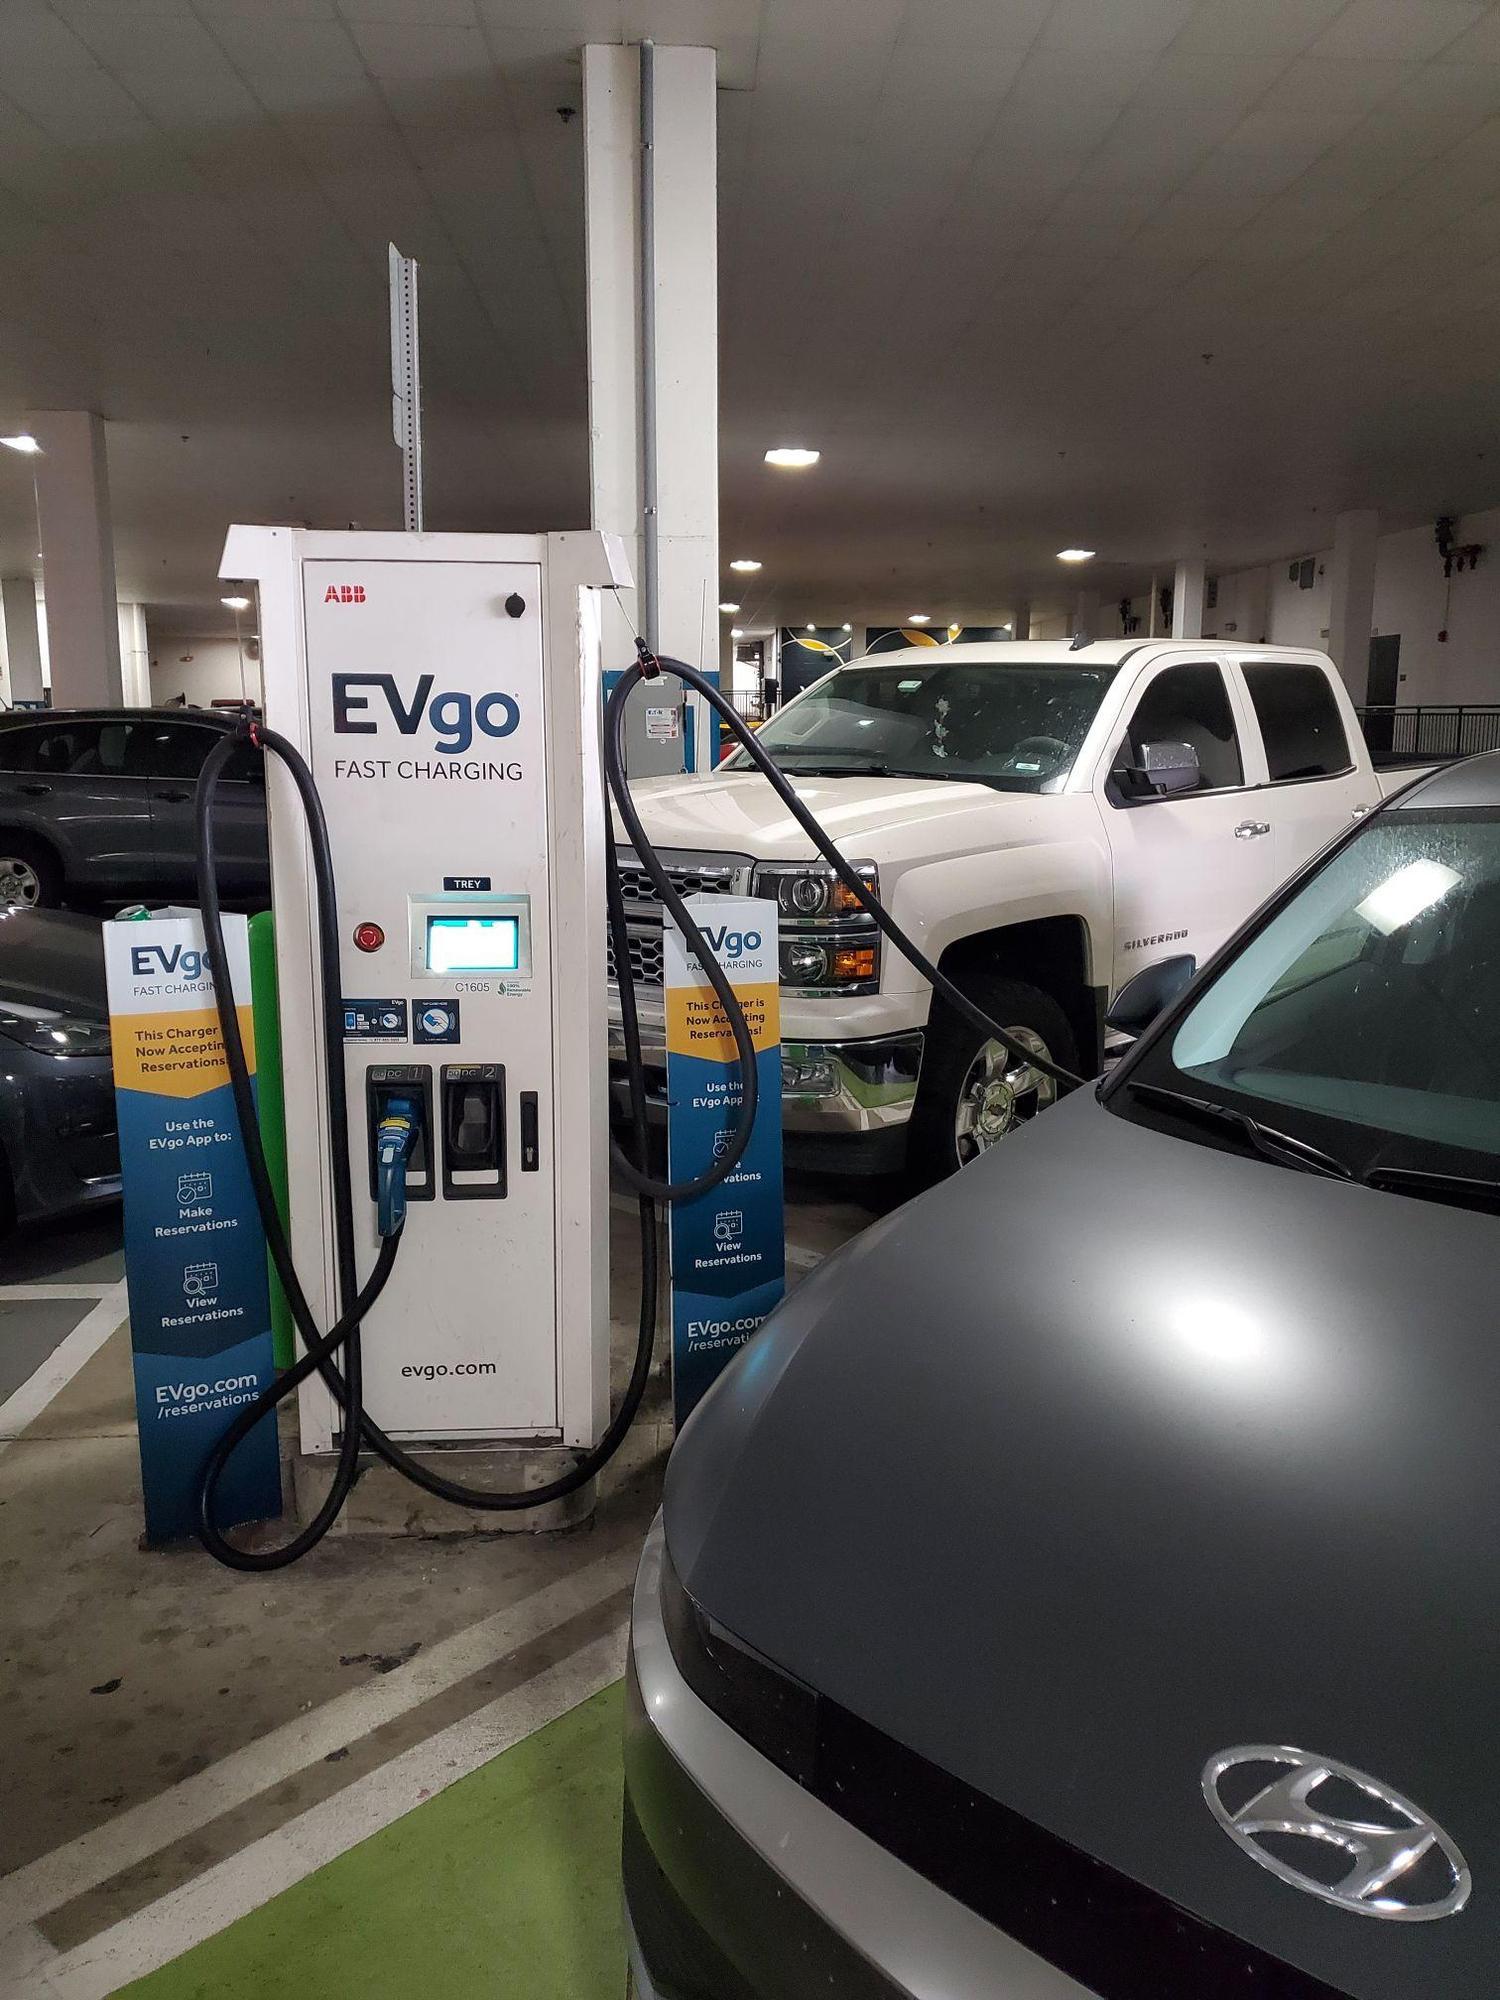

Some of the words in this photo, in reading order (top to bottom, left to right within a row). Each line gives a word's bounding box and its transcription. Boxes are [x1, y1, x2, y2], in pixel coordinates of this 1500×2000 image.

[324, 585, 366, 603] ABB
[332, 673, 520, 754] EVgo
[335, 760, 391, 779] FAST
[398, 761, 523, 781] CHARGING
[453, 880, 481, 889] TREY
[1123, 929, 1189, 950] SILVERADO
[687, 962, 704, 971] FAS
[719, 960, 763, 969] HARGING
[133, 985, 162, 997] FAST
[165, 981, 216, 994] CHARGIN
[455, 983, 490, 992] C1605
[686, 1002, 709, 1010] This
[756, 998, 764, 1007] is
[687, 1017, 710, 1025] Now
[712, 1012, 765, 1024] Accting
[135, 1031, 163, 1041] This
[167, 1027, 218, 1040] Charger
[690, 1026, 762, 1040] Reservans!
[136, 1047, 165, 1057] Now
[168, 1041, 225, 1056] Acceptin
[387, 1070, 402, 1078] DC
[484, 1066, 496, 1078] 2
[706, 1083, 727, 1093] Use
[692, 1098, 721, 1109] EVgo
[722, 1096, 743, 1106] App
[165, 1121, 190, 1132] Use
[192, 1118, 214, 1129] the
[149, 1138, 184, 1150] EVgo
[186, 1135, 212, 1147] App
[213, 1132, 232, 1142] to:
[179, 1206, 213, 1219] Make
[155, 1217, 238, 1237] Reservations
[715, 1242, 742, 1252] View
[695, 1252, 762, 1268] Reservations
[186, 1296, 218, 1308] View
[161, 1306, 244, 1328] Reservations
[401, 1363, 496, 1381] evgo.com
[155, 1374, 257, 1404] EVgo.com
[157, 1391, 260, 1419] /reservations
